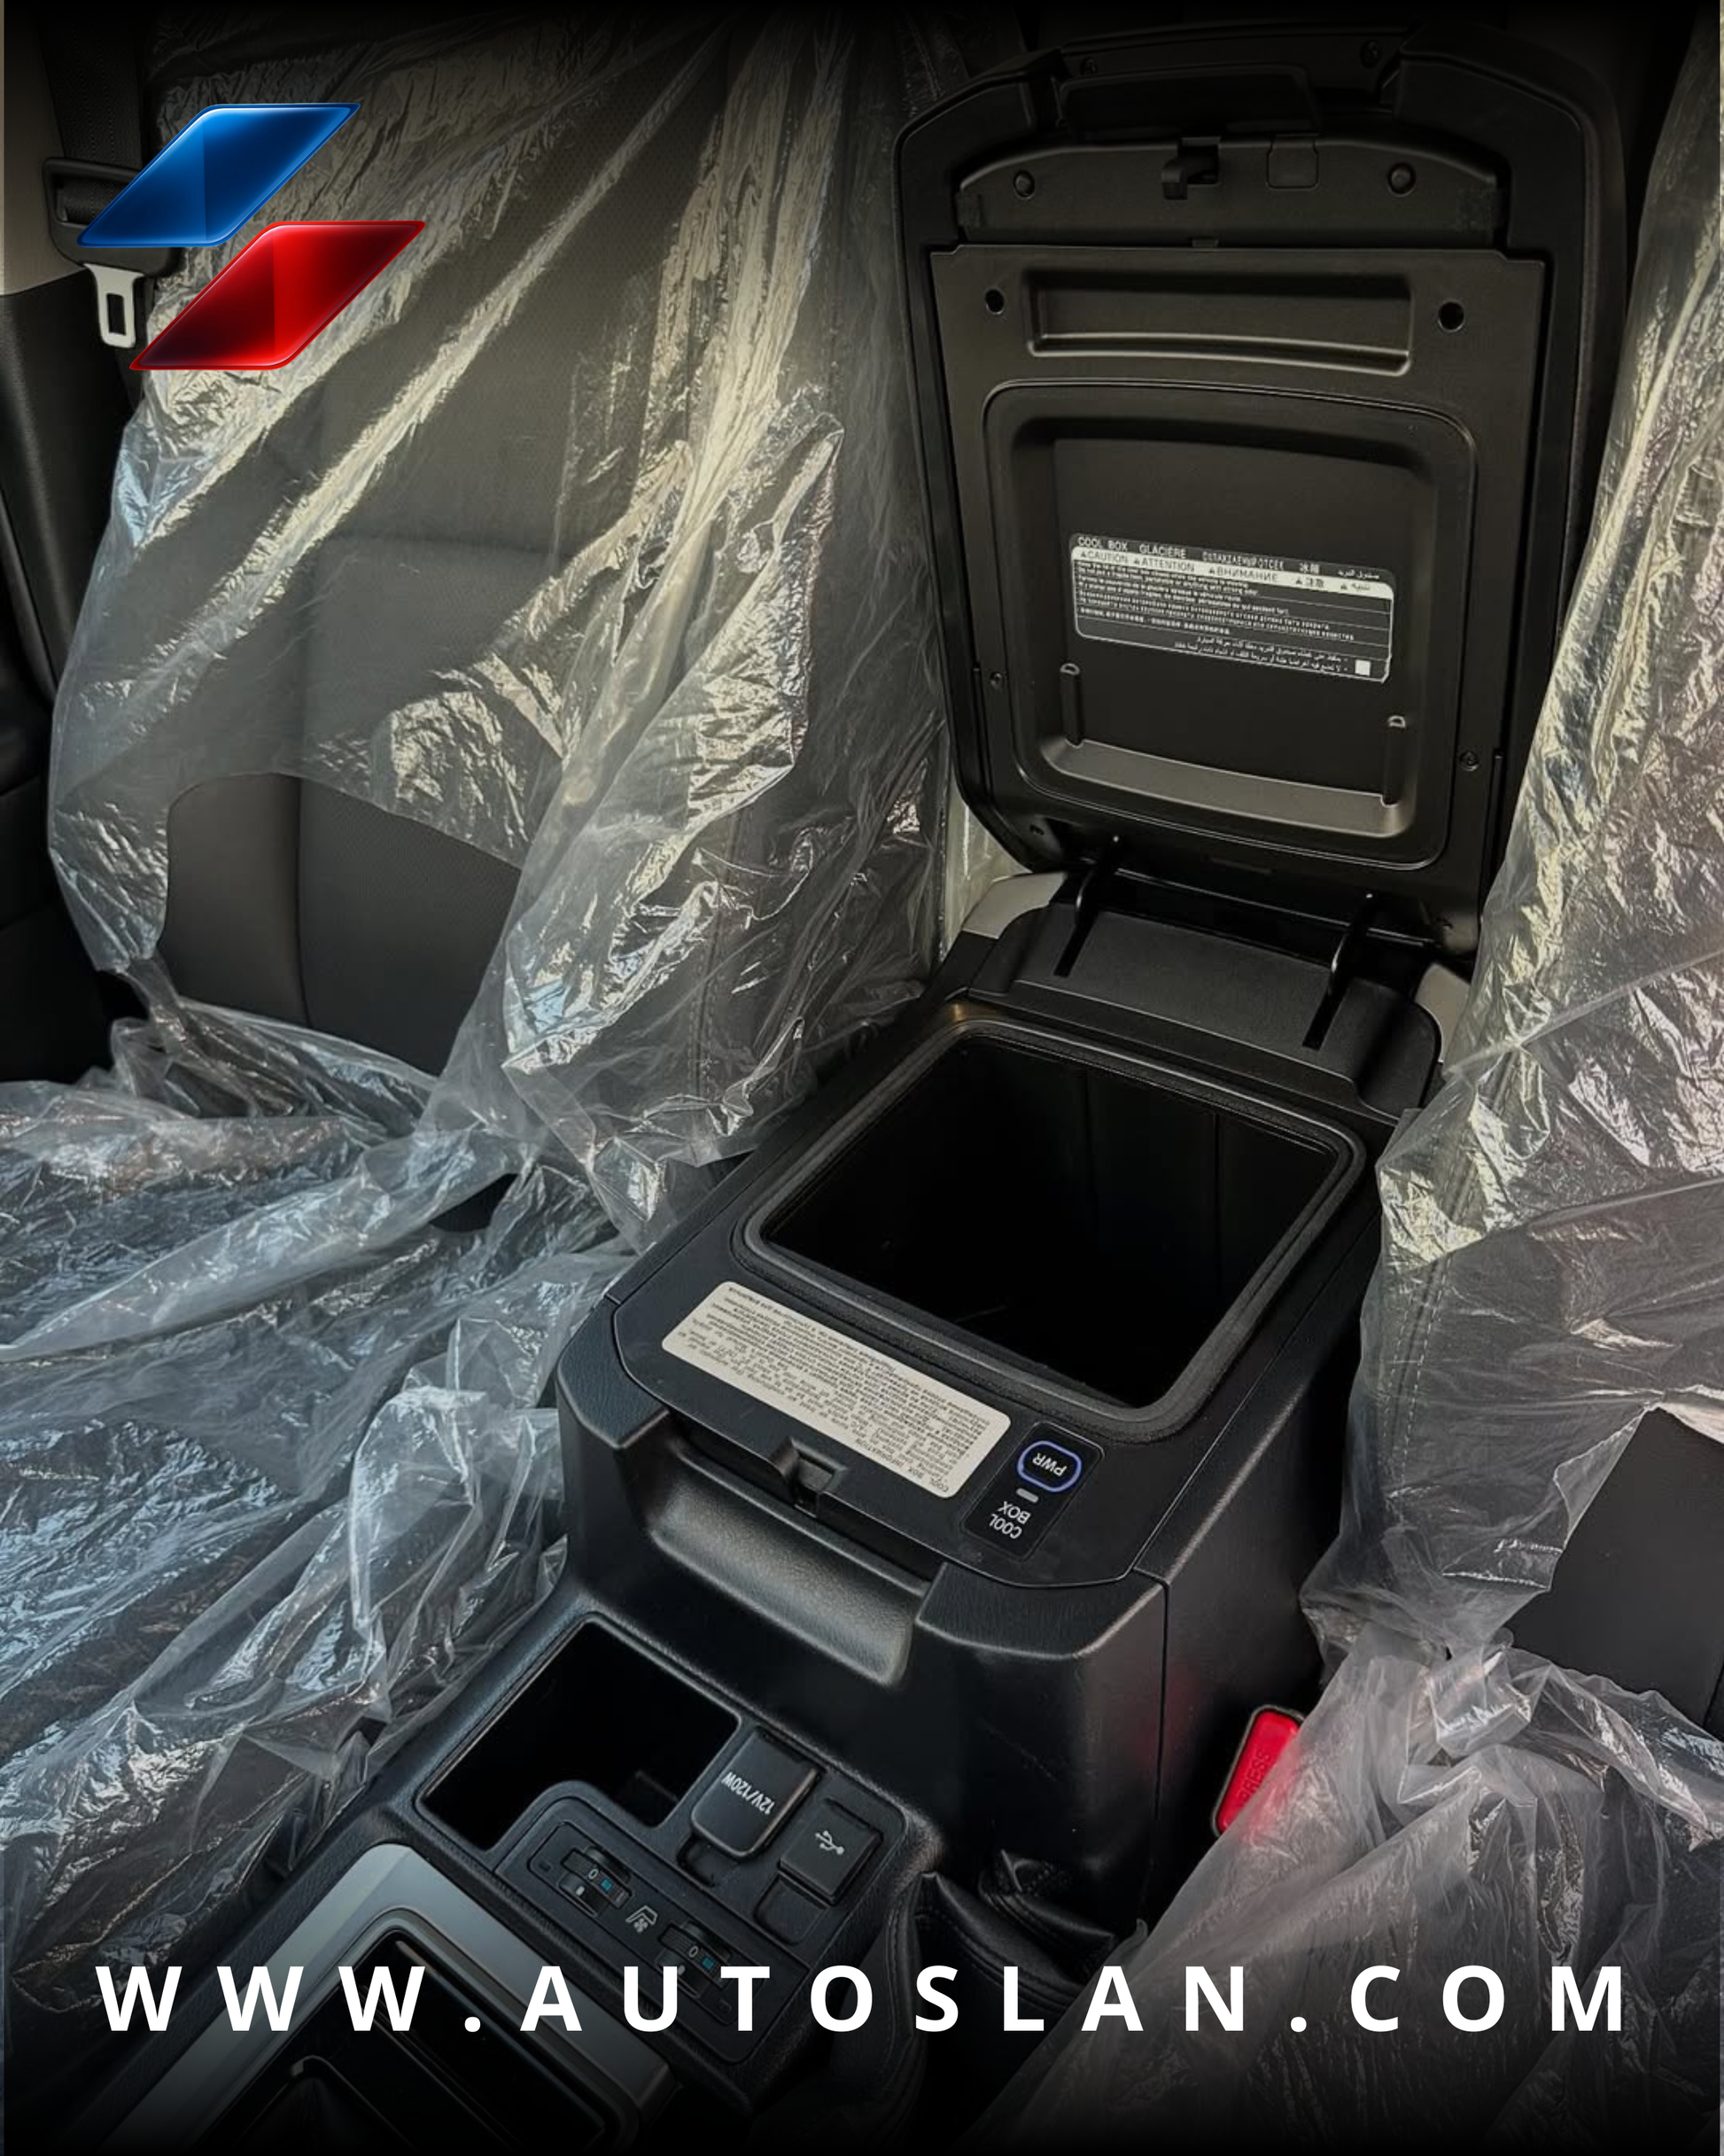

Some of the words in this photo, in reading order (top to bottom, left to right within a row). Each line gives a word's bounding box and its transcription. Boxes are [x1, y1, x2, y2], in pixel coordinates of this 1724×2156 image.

[1077, 536, 1102, 549] COOL
[1107, 540, 1128, 551] BOX
[1087, 549, 1129, 564] CAUTION
[1140, 557, 1195, 573] ATTENTION
[1215, 567, 1278, 583] ВНИМАНИЕ
[1032, 1452, 1068, 1477] PWR
[998, 1500, 1031, 1525] BOX
[989, 1513, 1022, 1539] COOL
[720, 1771, 776, 1816] 12V/120W
